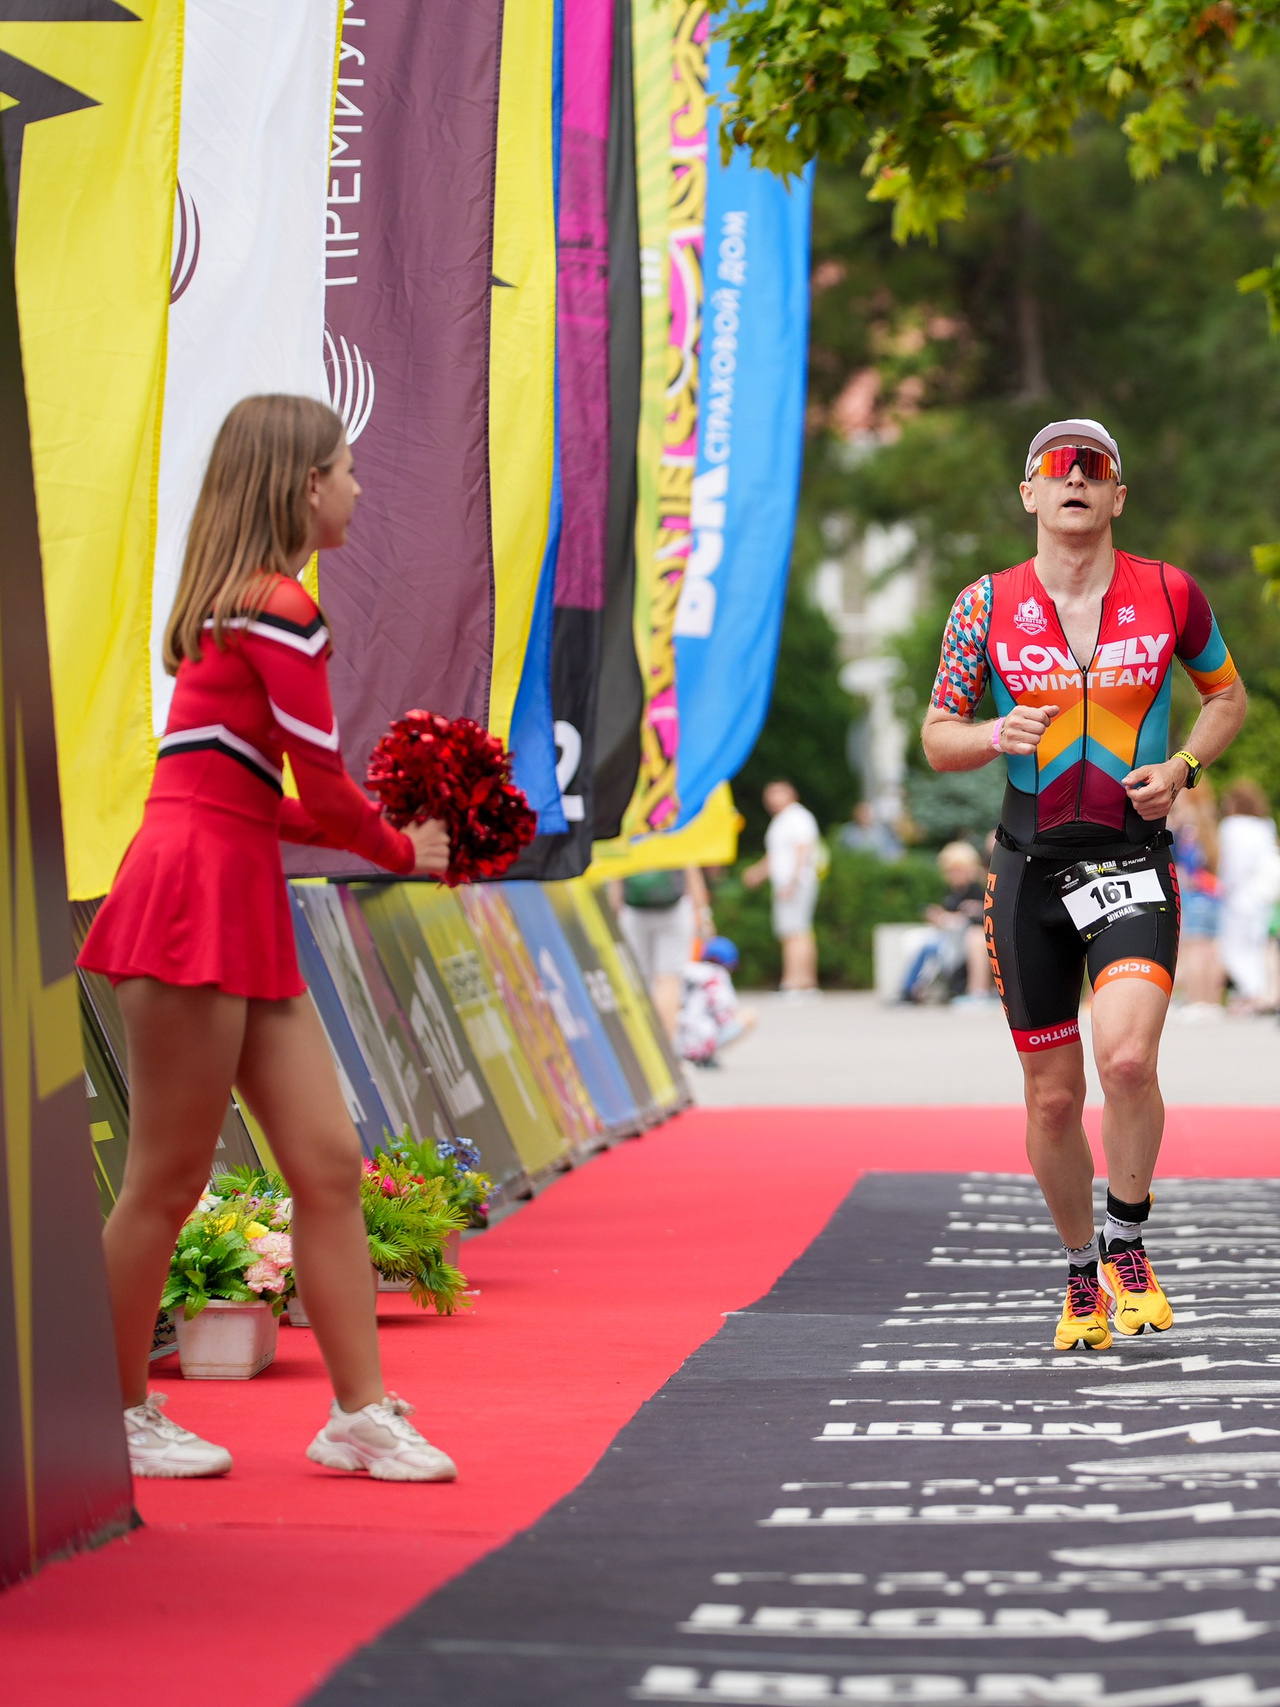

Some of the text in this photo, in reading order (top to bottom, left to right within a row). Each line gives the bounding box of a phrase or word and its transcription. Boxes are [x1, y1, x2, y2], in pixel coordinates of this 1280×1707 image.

[716, 210, 749, 286] ДОМ
[996, 633, 1170, 672] LOVELY
[1090, 880, 1132, 910] 167
[1106, 905, 1135, 923] MIKHAIL
[858, 1355, 1122, 1370] IRON
[822, 1421, 1122, 1436] IRON
[769, 1502, 1120, 1521] IRON
[688, 1602, 1110, 1632] IRON
[640, 1664, 1104, 1700] IRON
